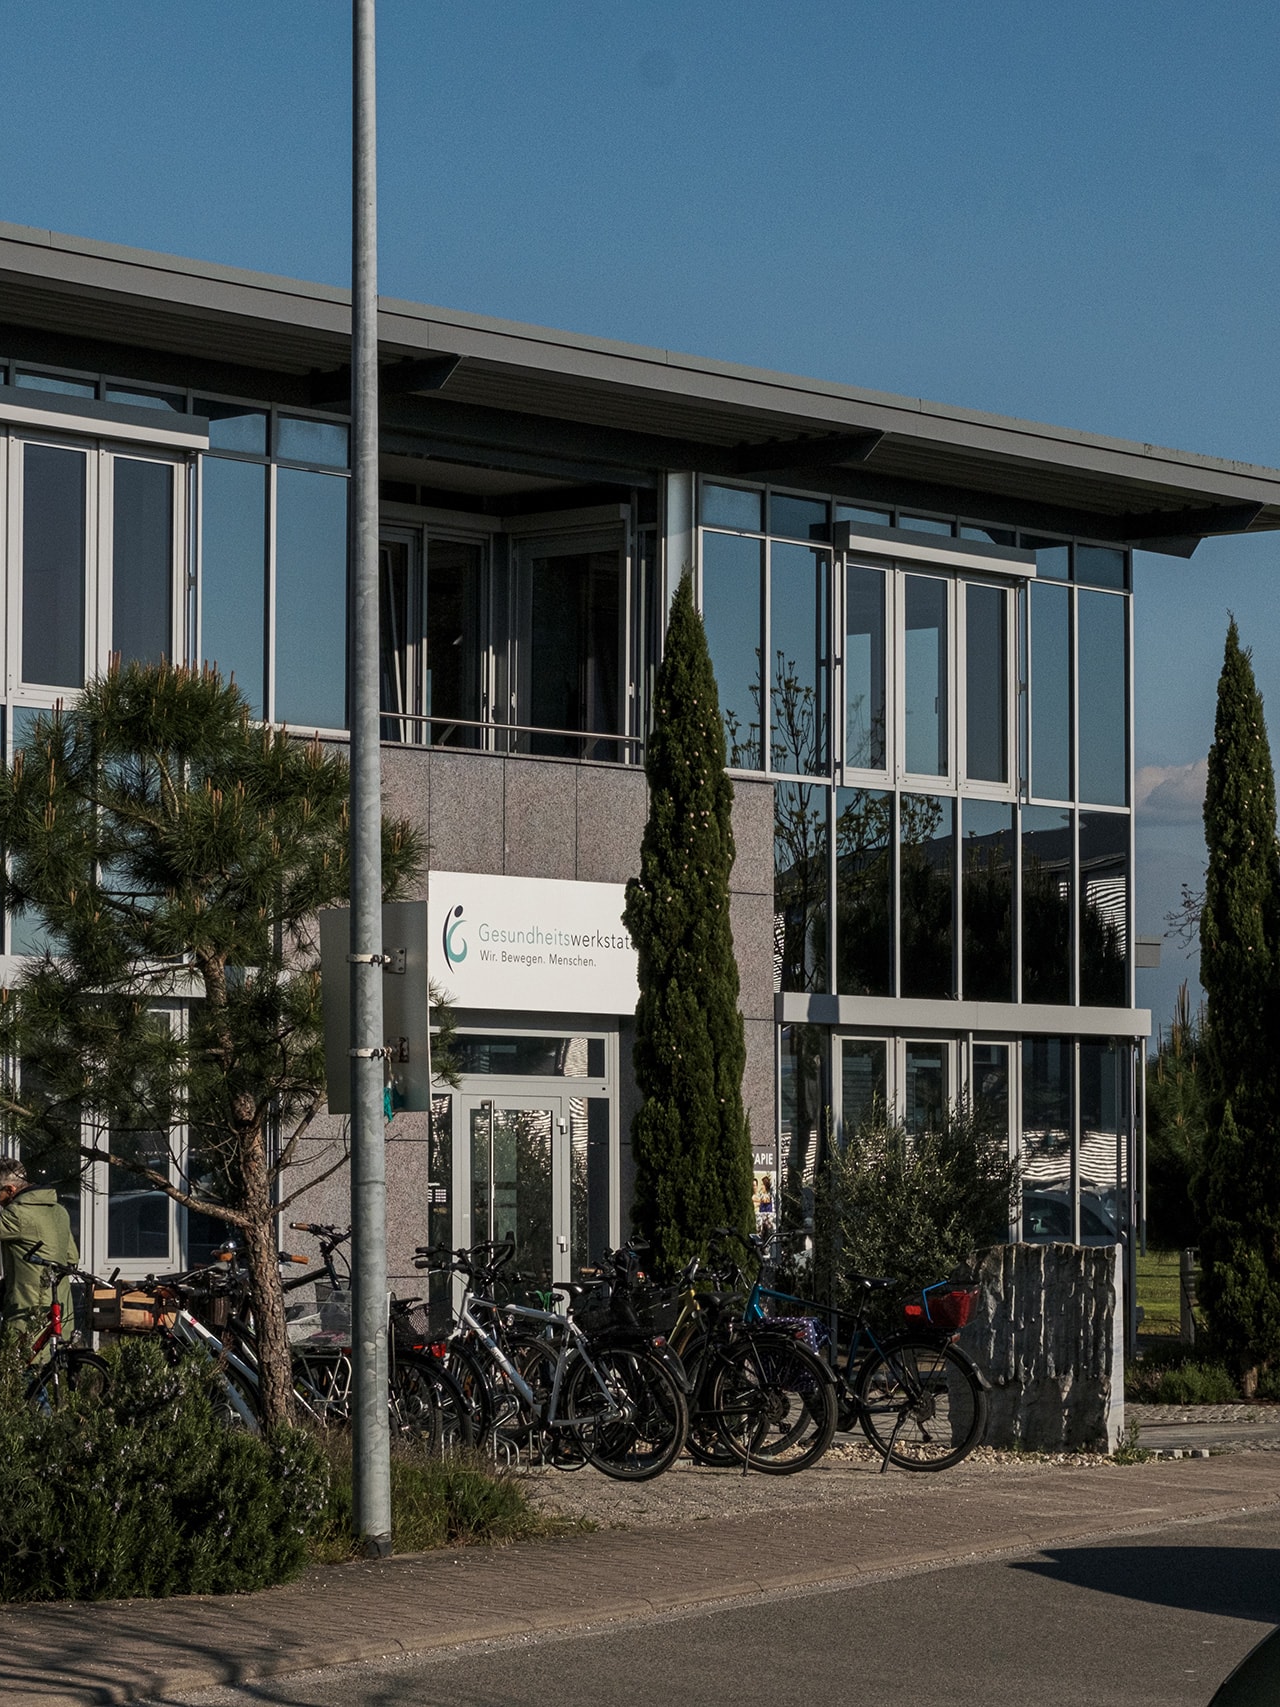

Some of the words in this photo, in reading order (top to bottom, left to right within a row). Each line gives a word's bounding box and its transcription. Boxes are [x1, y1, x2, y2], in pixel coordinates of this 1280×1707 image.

[479, 923, 631, 950] Gesundheitswerkstat
[480, 949, 498, 962] Wir.
[501, 950, 546, 967] Bewegen.
[549, 953, 597, 967] Menschen.
[752, 1153, 773, 1165] APIE
